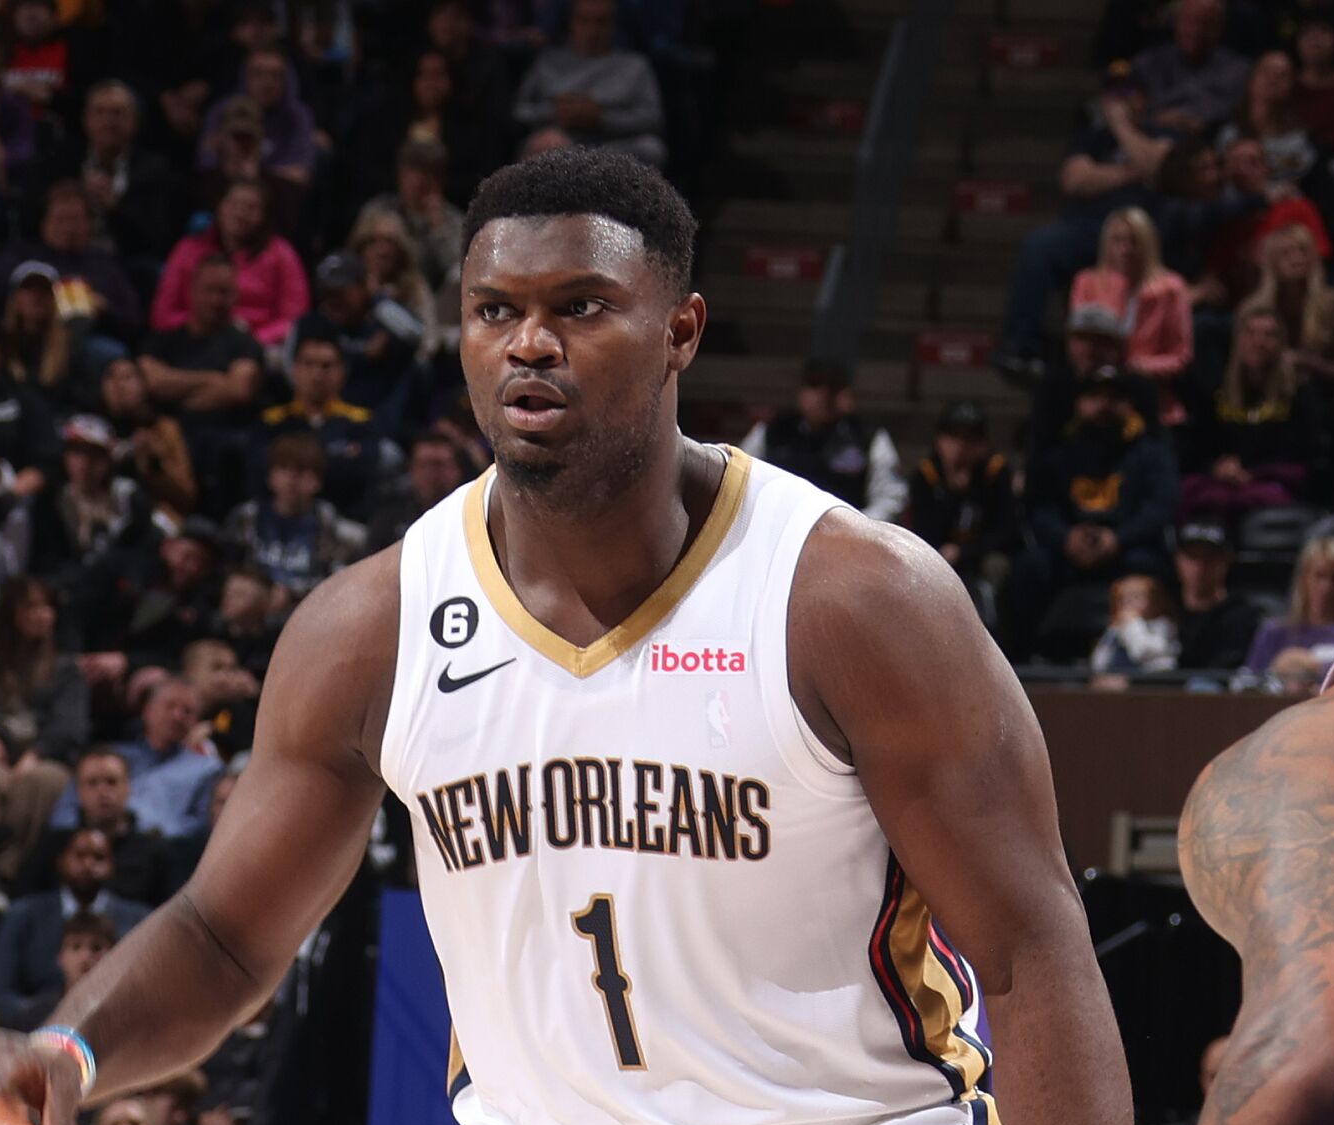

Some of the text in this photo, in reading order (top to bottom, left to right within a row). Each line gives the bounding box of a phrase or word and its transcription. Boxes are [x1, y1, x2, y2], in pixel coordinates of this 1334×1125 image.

[442, 603, 469, 643] 6
[651, 644, 745, 672] ibotta
[417, 756, 771, 873] NEW ORLEANS
[570, 893, 648, 1071] 1
